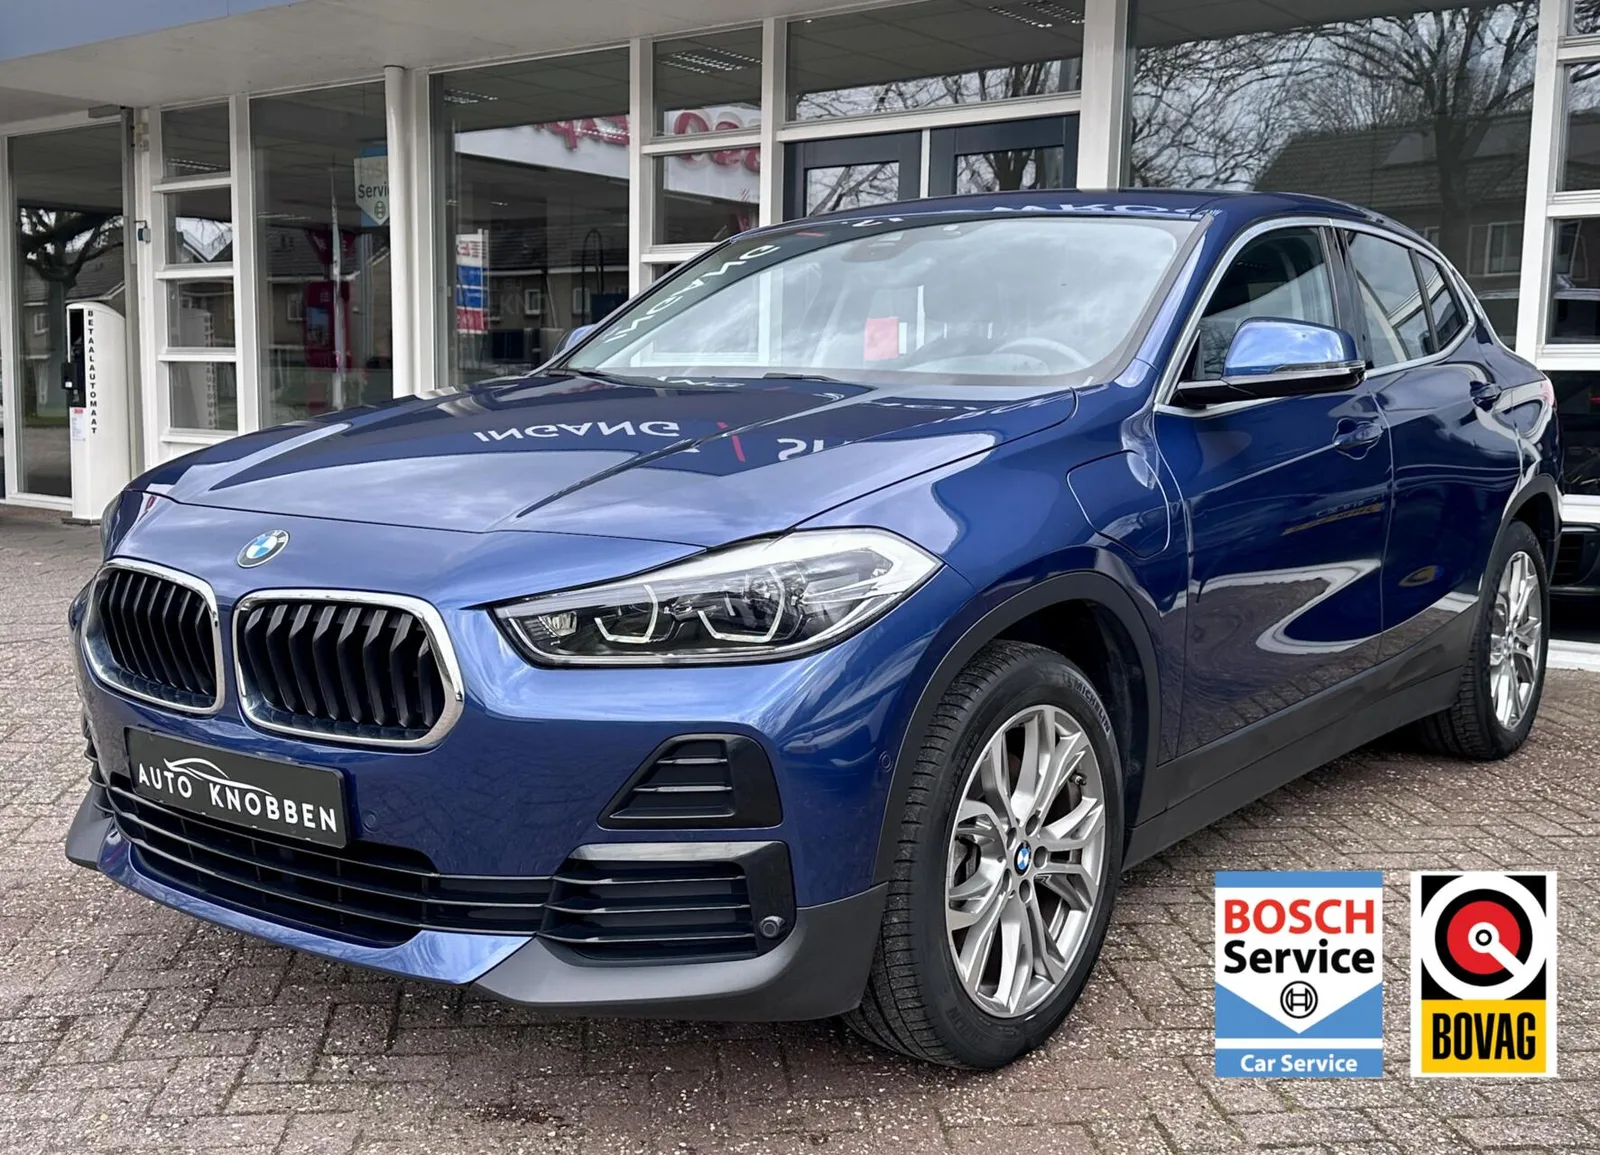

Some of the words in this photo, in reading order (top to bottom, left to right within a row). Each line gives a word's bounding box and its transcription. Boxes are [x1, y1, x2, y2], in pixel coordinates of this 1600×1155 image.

[358, 181, 389, 198] Servi
[87, 310, 97, 434] BETAALAUTOMAAT
[138, 763, 193, 799] AUTO
[210, 783, 337, 833] KNOBBEN
